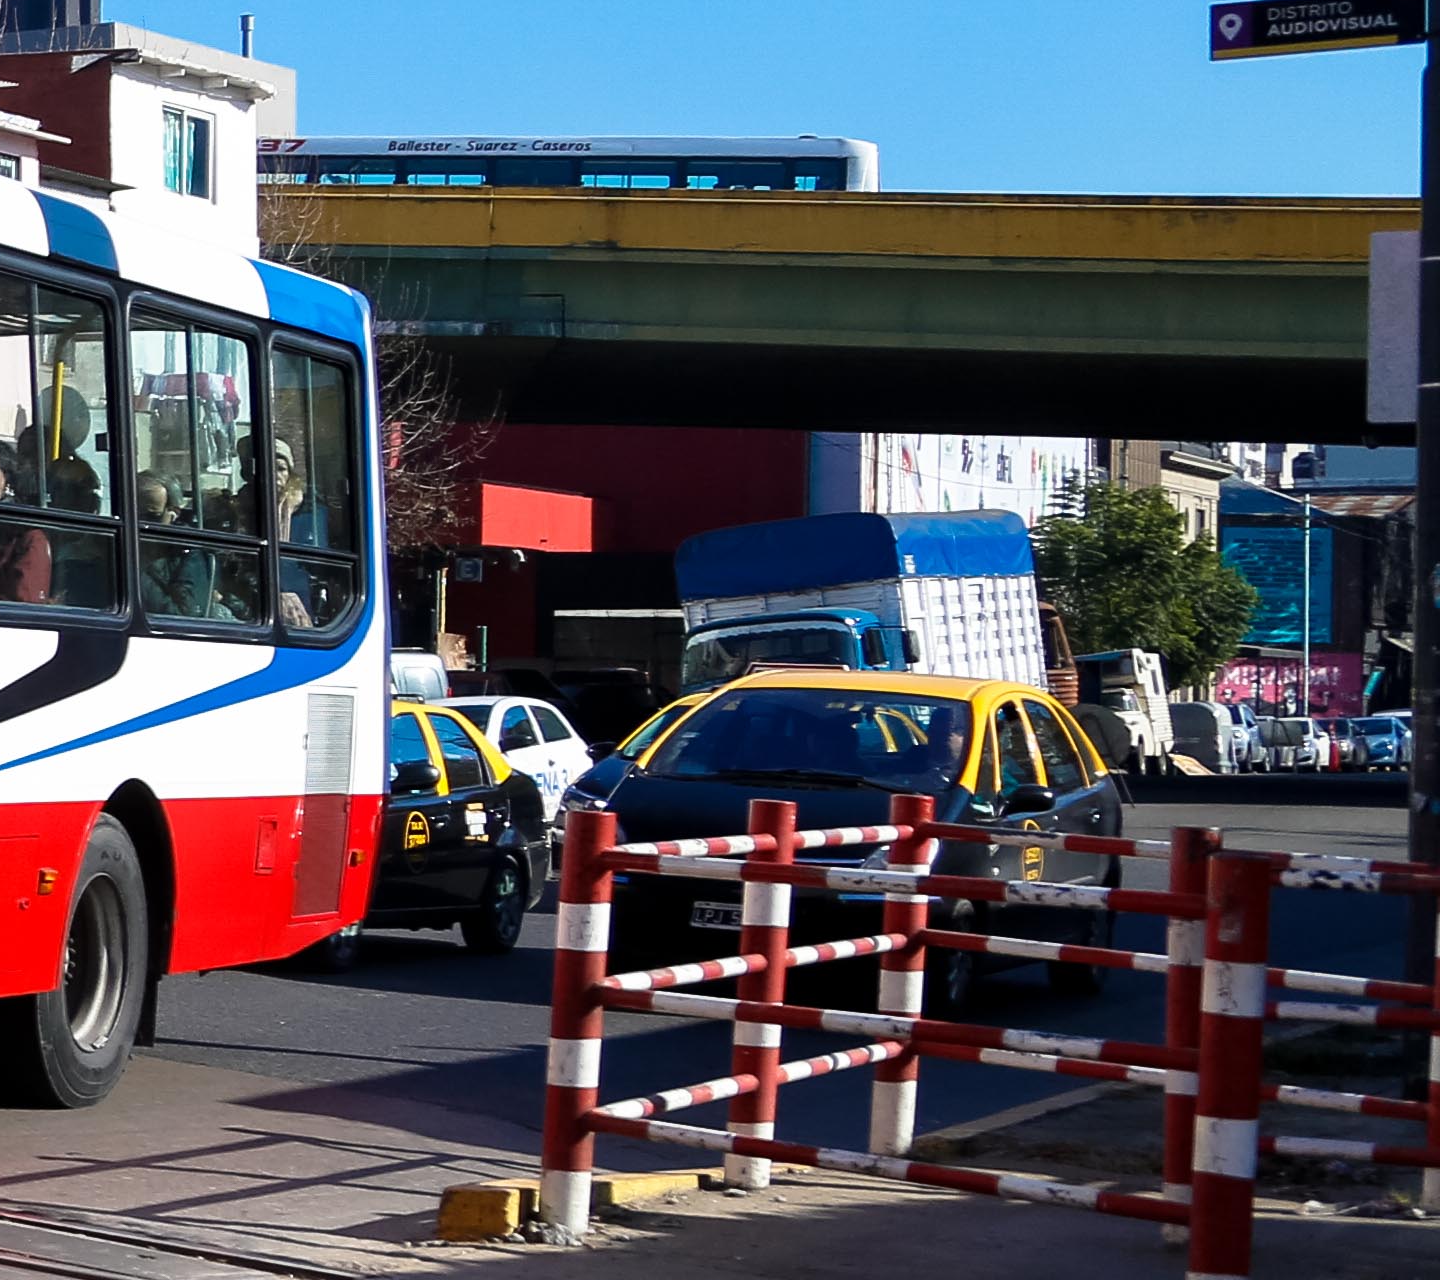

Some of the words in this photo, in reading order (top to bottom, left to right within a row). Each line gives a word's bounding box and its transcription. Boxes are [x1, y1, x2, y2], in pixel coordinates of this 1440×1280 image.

[1266, 1, 1353, 21] DISTRITO
[1266, 14, 1399, 37] AUDIOVISUAL
[387, 140, 450, 152] Ballester
[465, 140, 518, 152] Suarez
[531, 139, 592, 152] Caseros
